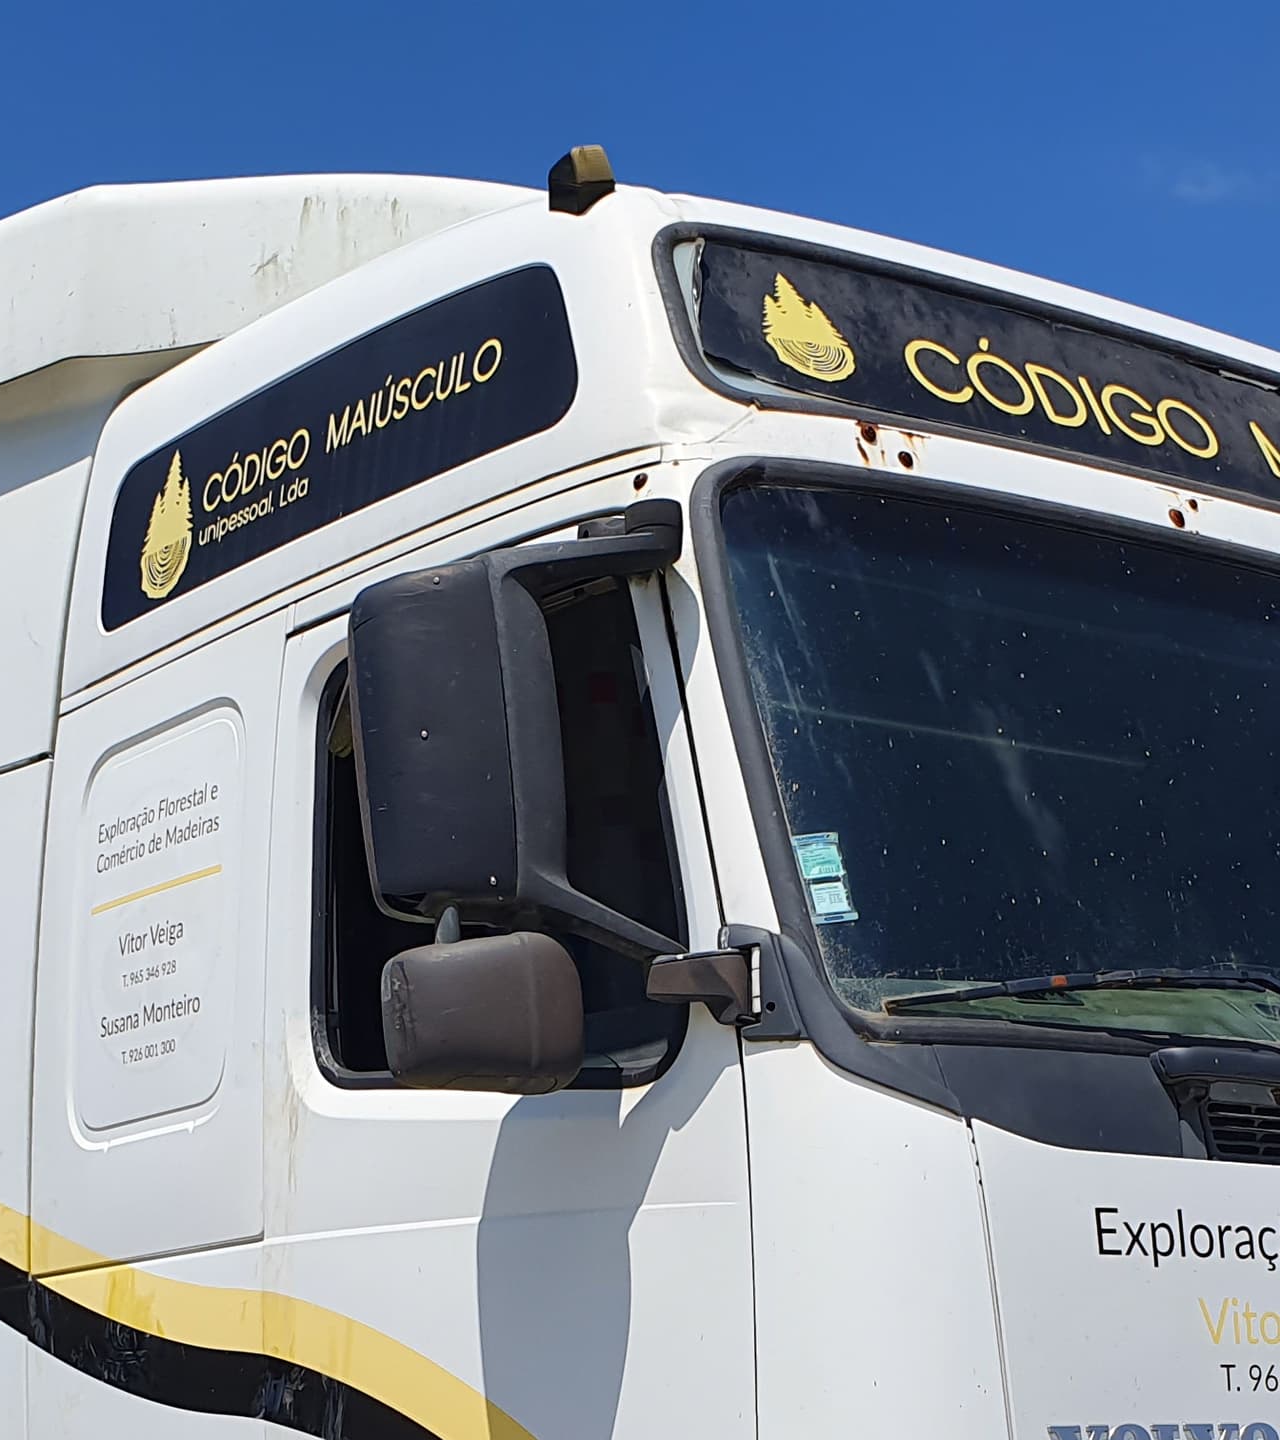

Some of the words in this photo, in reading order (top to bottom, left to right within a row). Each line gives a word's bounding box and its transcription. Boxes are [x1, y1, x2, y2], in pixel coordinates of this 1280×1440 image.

[903, 336, 1220, 459] CÓDIGO
[203, 428, 310, 512] CÓDIGO
[325, 338, 502, 454] MAIÚSCULO
[199, 491, 274, 546] unipessoal,
[279, 477, 309, 508] Lda
[98, 807, 155, 844] Exploração
[158, 782, 207, 821] Florestal
[210, 784, 218, 801] e
[96, 840, 145, 873] Comércio
[148, 833, 162, 854] de
[165, 816, 220, 849] Madeiras
[119, 932, 147, 957] Vitor
[150, 919, 184, 946] Veiga
[130, 969, 144, 985] 965
[145, 964, 160, 981] 346
[161, 959, 177, 976] 928
[100, 1012, 140, 1038] Susana
[143, 993, 201, 1027] Monteiro
[129, 1047, 143, 1063] 926
[144, 1043, 159, 1059] 001
[160, 1038, 176, 1055] 300
[1220, 1364, 1242, 1393] T.
